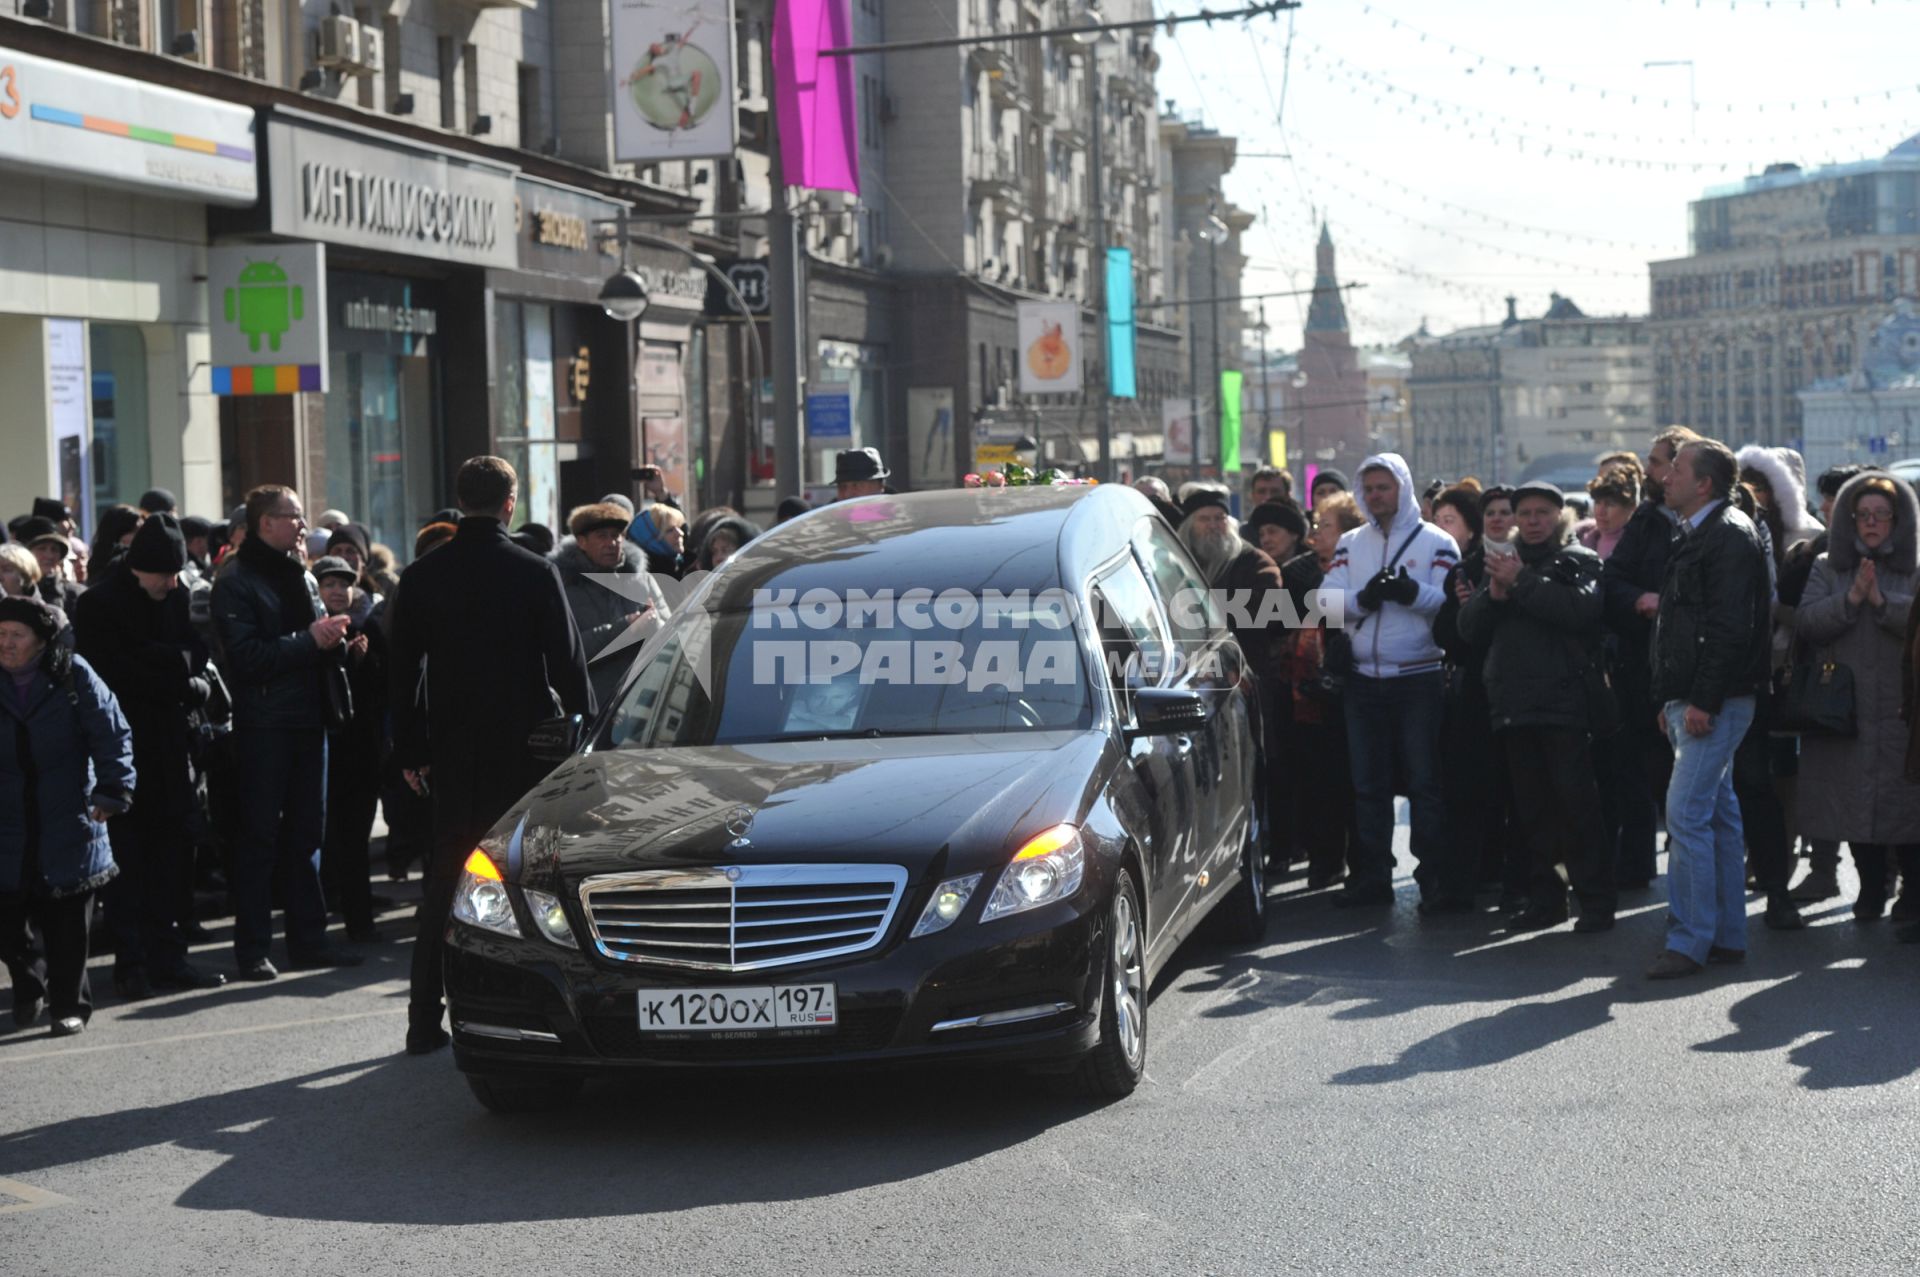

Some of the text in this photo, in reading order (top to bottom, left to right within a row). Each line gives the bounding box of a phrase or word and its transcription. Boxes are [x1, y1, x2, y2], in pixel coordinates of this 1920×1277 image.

[303, 161, 497, 247] ИНТИМИССИМИ
[345, 297, 437, 335] intimissimi
[778, 987, 825, 1013] 197
[790, 1013, 814, 1022] RUS
